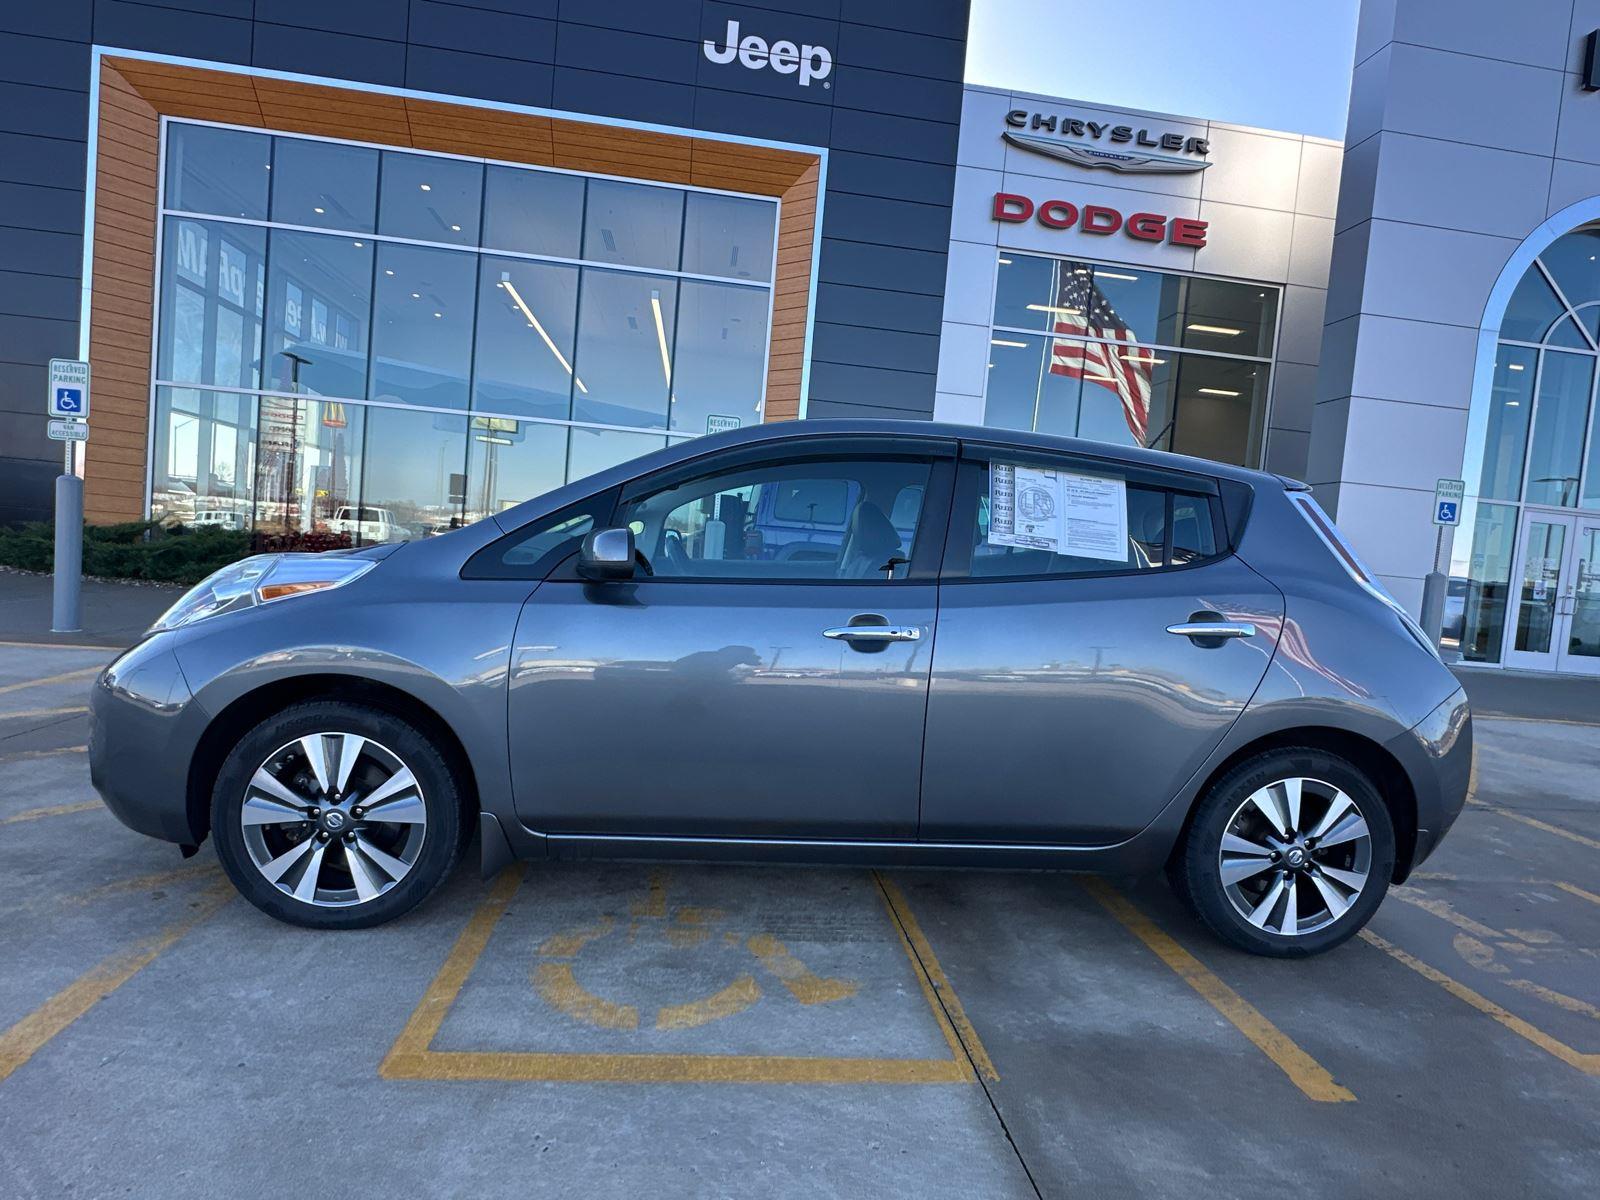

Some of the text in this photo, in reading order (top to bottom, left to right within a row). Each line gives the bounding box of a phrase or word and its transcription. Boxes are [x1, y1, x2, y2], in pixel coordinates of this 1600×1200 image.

[704, 20, 832, 86] Jeep
[1006, 110, 1210, 154] CHRYSLER
[993, 192, 1208, 248] DODGE
[54, 364, 86, 375] RESERVED
[53, 374, 86, 384] PARKING
[710, 418, 738, 428] RESERVED
[51, 430, 86, 438] ACCESSIBLE
[1439, 482, 1462, 491] RESERVED
[1437, 490, 1461, 499] PARKING
